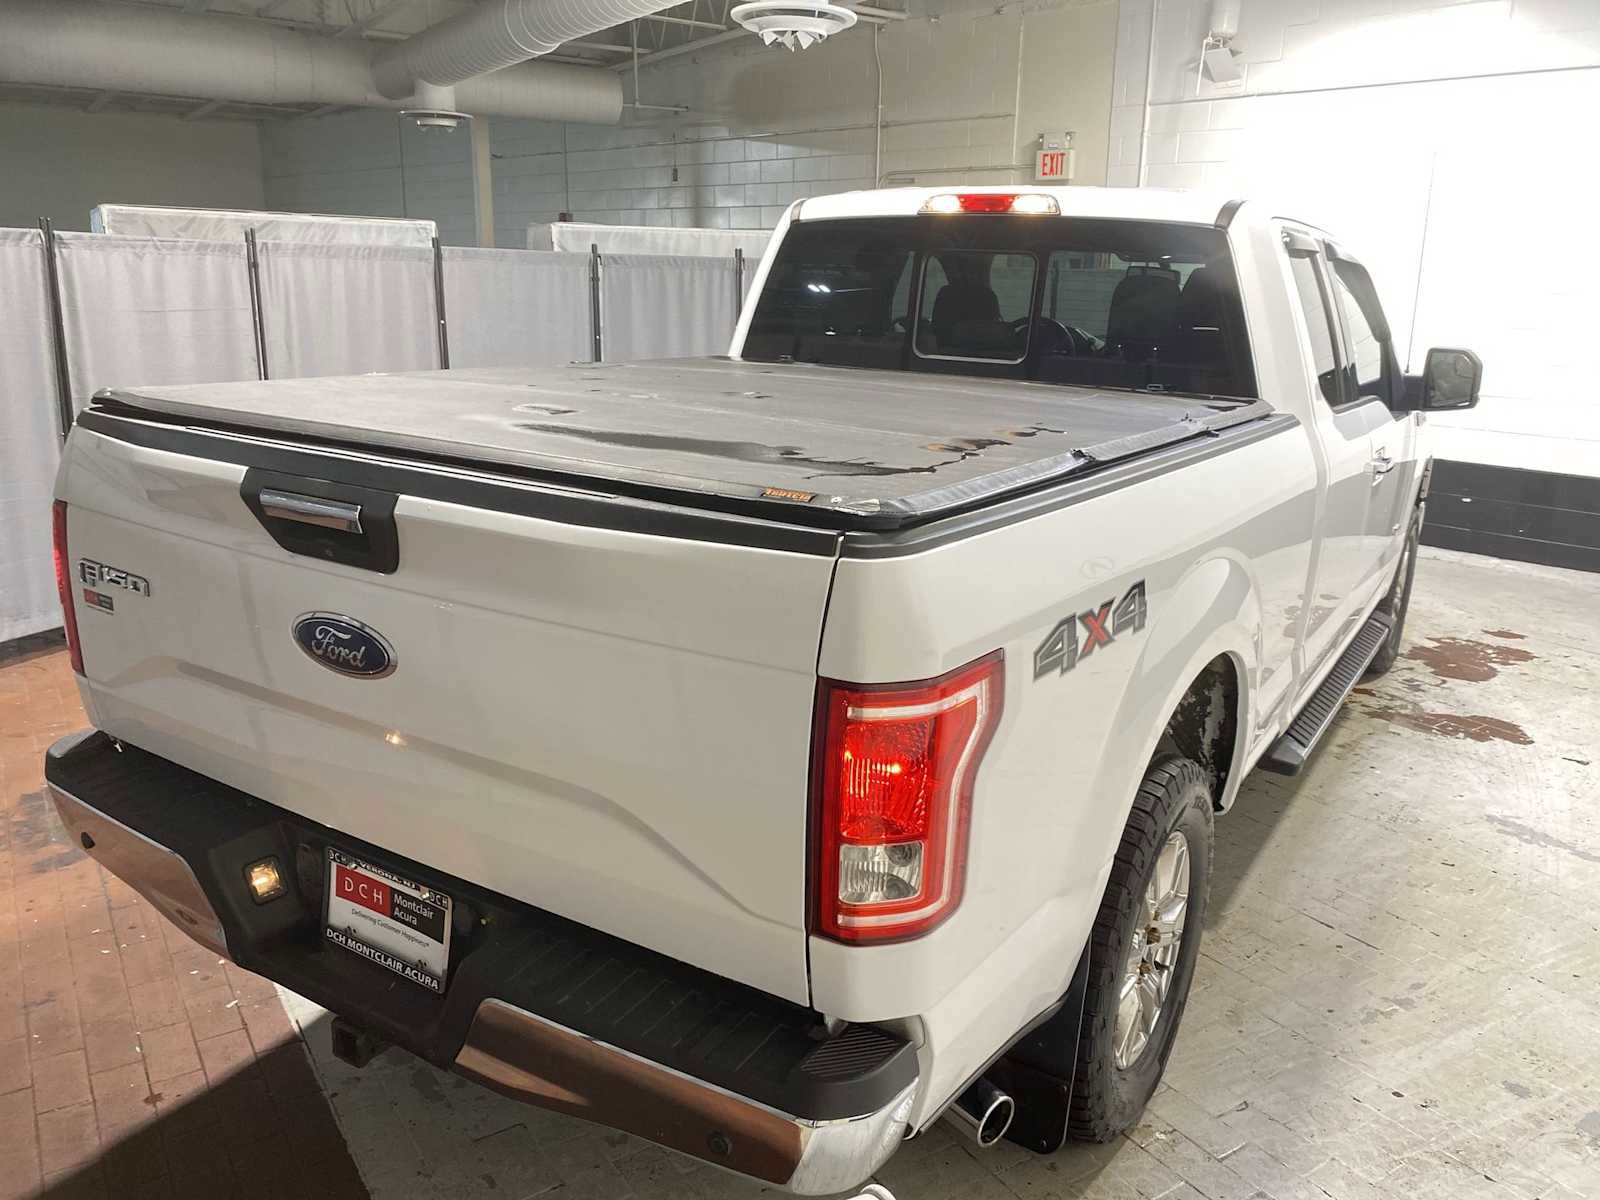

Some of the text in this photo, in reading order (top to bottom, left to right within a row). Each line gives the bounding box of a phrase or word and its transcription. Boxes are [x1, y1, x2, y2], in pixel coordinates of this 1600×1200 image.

[1041, 152, 1066, 176] EXIT
[311, 625, 366, 668] Ford
[344, 876, 383, 905] DCH
[393, 893, 434, 920] Montclair
[393, 906, 418, 926] Acura
[326, 928, 439, 990] DCH MONTCLAIR ACURA
